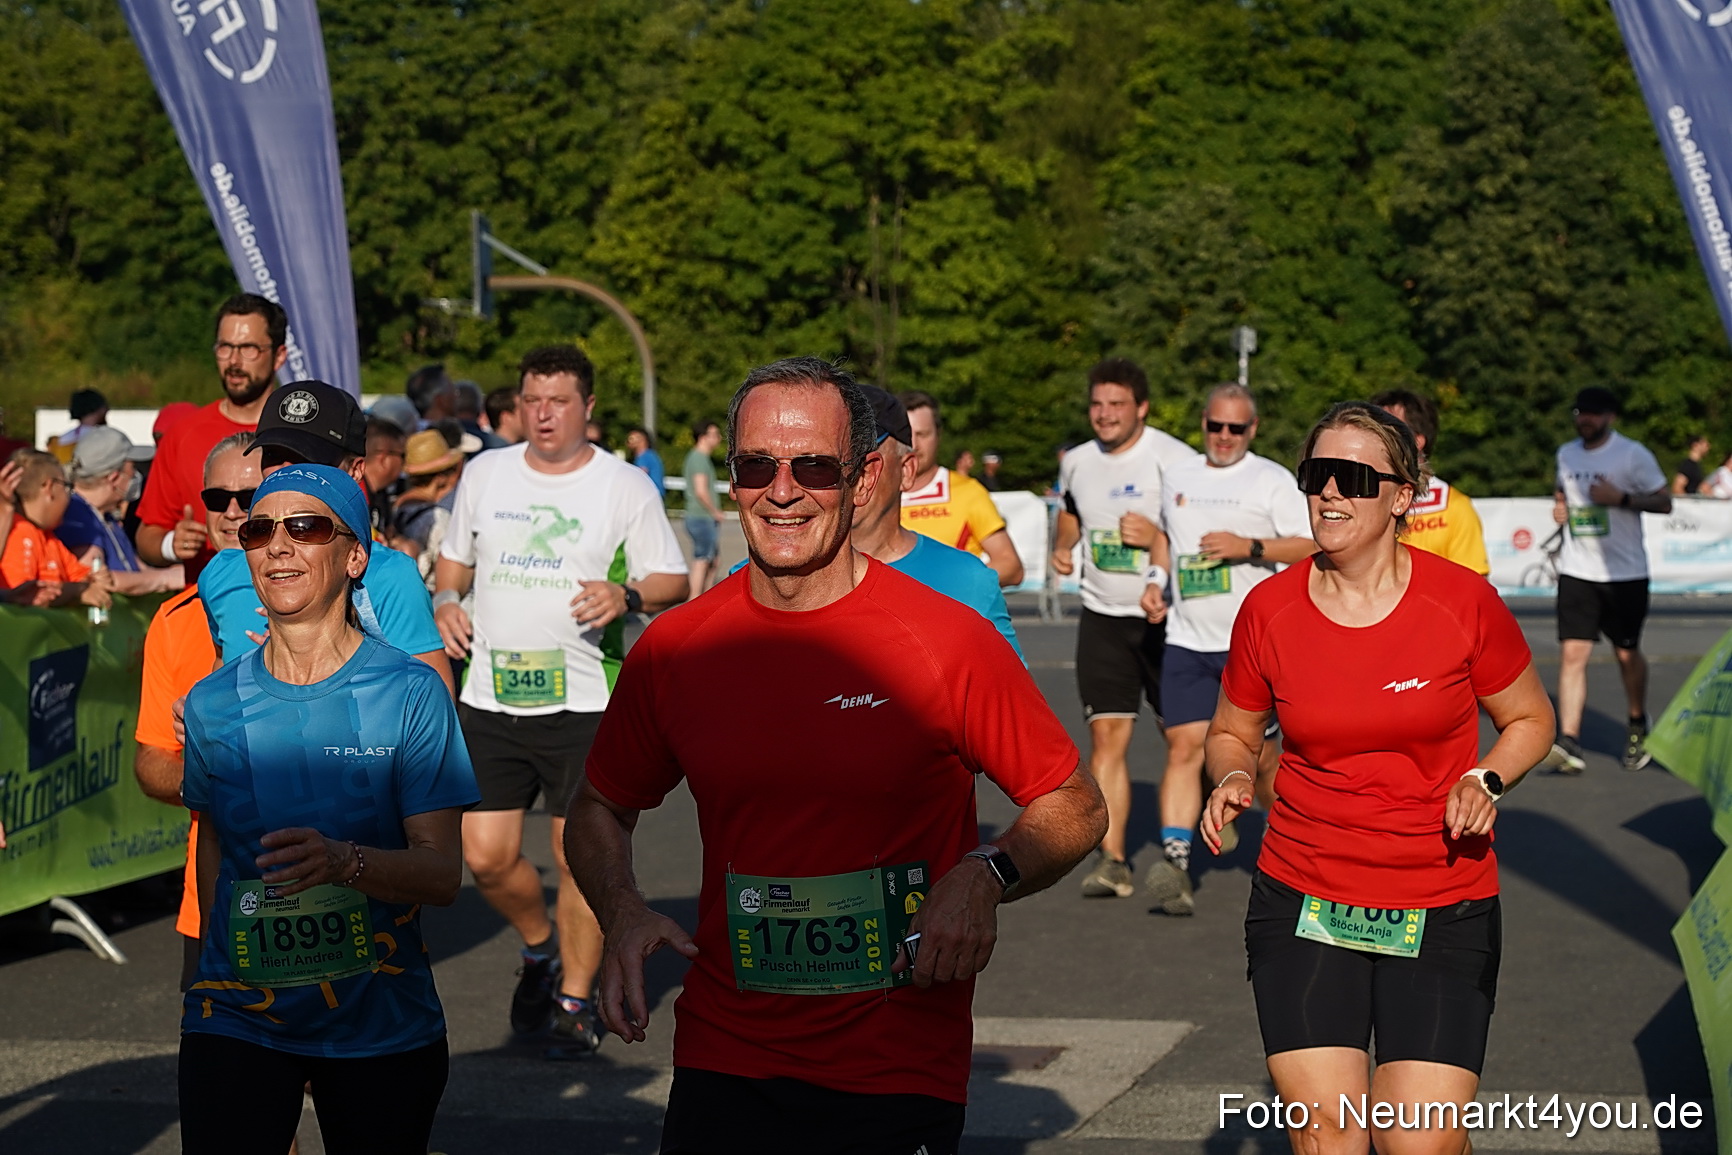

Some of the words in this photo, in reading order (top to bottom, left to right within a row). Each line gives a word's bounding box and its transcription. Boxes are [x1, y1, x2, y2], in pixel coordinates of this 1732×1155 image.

[500, 551, 563, 570] Laufend
[491, 571, 573, 589] erfolgreich
[508, 670, 546, 688] 348
[1395, 677, 1419, 693] DEHN
[840, 693, 873, 709] DEHN
[344, 746, 395, 757] PLAST
[889, 880, 897, 896] AOK
[259, 897, 301, 908] Firmenlauf
[763, 898, 811, 908] Firmenlauf
[1308, 896, 1322, 921] RU
[250, 912, 347, 953] 1899
[349, 911, 369, 959] 2022
[754, 915, 861, 956] 1763
[1329, 917, 1364, 934] Stöckl
[1366, 924, 1393, 939] Anja
[235, 930, 251, 969] RUN
[738, 928, 754, 969] RUN
[864, 917, 883, 973] 2022
[260, 955, 291, 969] Hierl
[294, 950, 344, 966] Andrea
[759, 958, 801, 973] Pusch
[806, 957, 861, 973] Helmut
